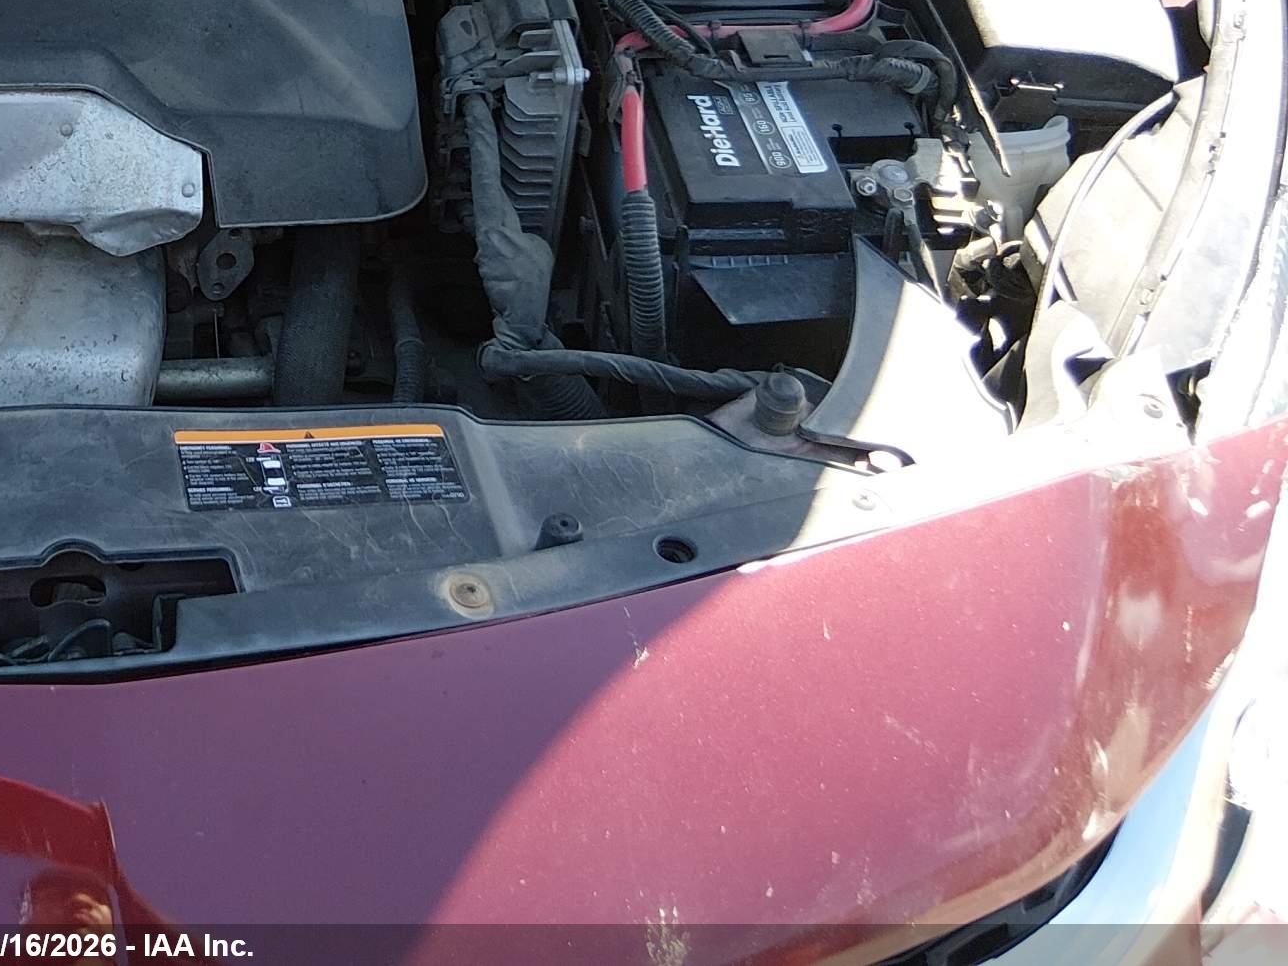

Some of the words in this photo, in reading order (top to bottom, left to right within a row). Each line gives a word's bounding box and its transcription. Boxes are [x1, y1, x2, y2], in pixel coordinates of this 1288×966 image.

[687, 95, 741, 167] DieHard
[756, 120, 770, 132] 160
[772, 151, 786, 166] 900
